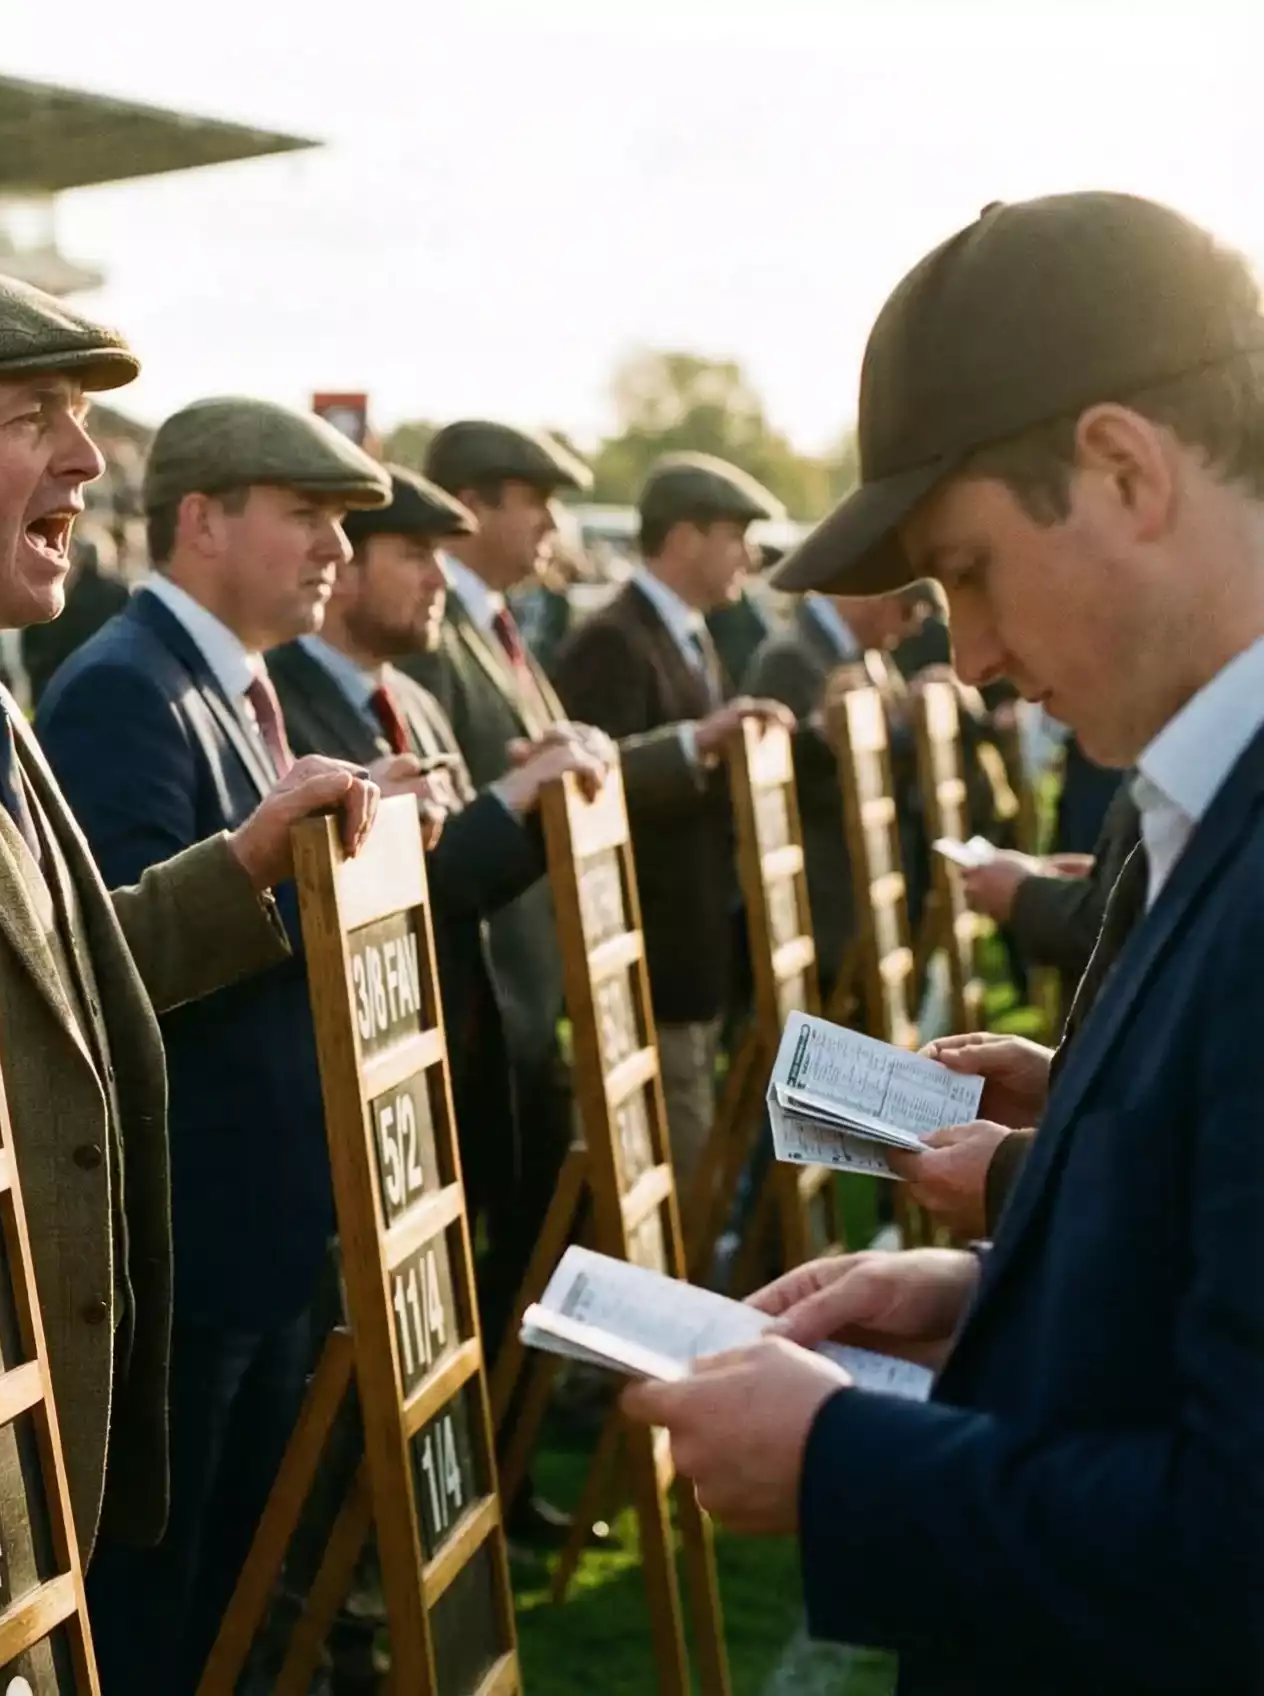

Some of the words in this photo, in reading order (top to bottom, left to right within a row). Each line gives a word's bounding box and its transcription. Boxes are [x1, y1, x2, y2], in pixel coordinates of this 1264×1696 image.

[382, 932, 421, 1022] FAV
[380, 1093, 423, 1208] 5/2
[394, 1250, 446, 1375] 11/4
[422, 1415, 462, 1532] 1/4
